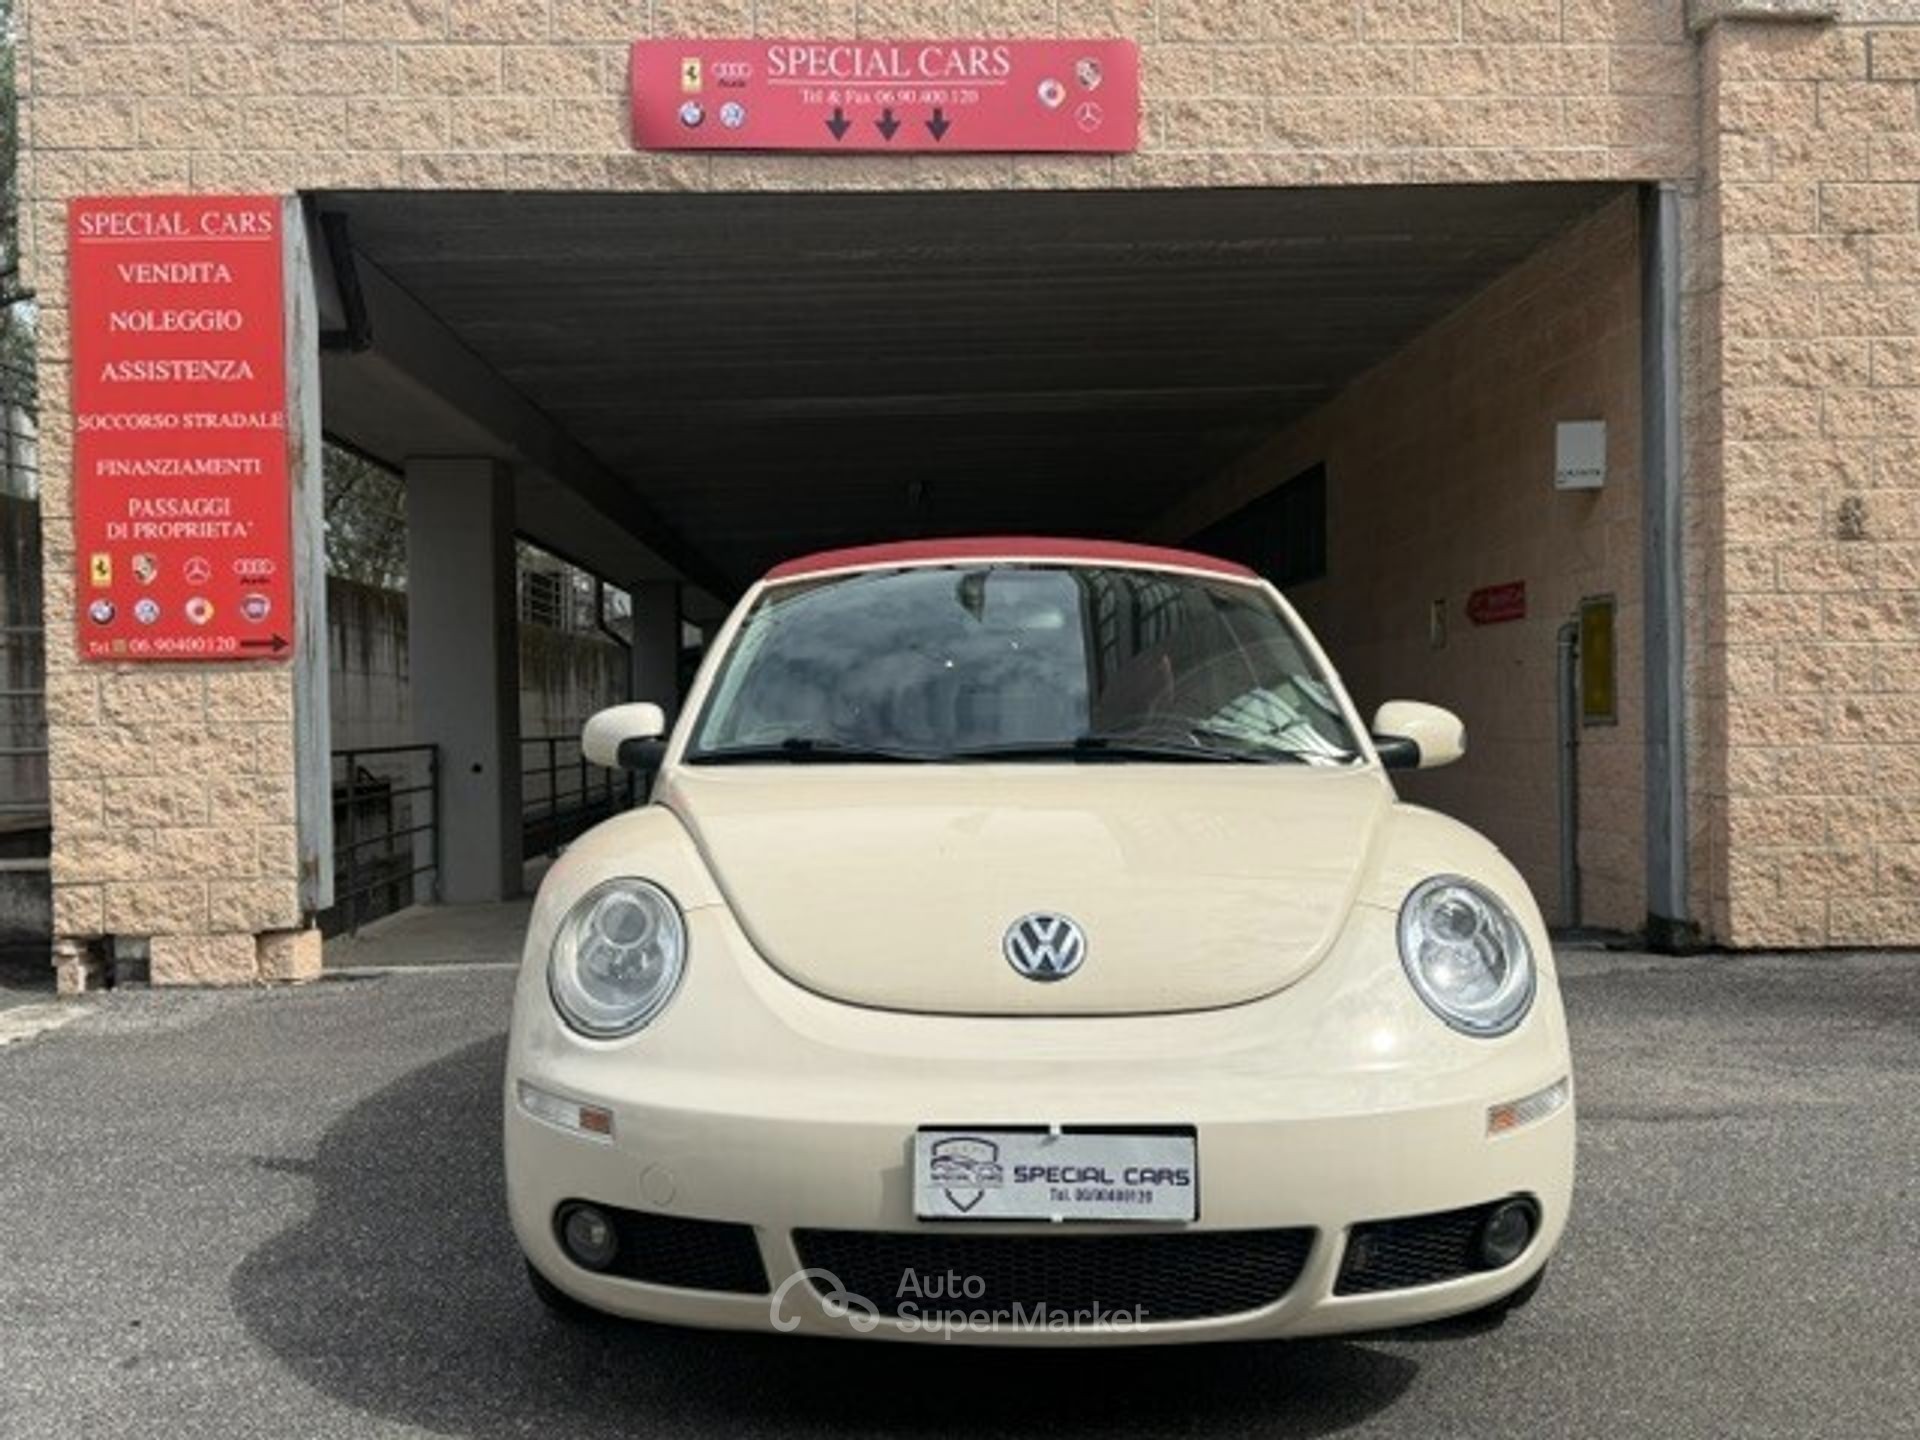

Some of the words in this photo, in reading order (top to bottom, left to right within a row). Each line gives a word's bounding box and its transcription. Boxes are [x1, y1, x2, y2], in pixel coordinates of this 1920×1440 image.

[767, 46, 912, 77] SPECIAL
[918, 45, 1011, 76] CARS
[79, 212, 190, 235] SPECIAL
[201, 211, 272, 233] CARS
[117, 263, 232, 283] VENDITA
[109, 309, 242, 331] NOLEGGIO
[101, 360, 254, 381] ASSISTENZA
[77, 413, 178, 430] SOCCORSO
[183, 412, 284, 429] STRADALE
[96, 459, 262, 476] FINANZIAMENTI
[128, 498, 231, 517] PASSAGGI
[107, 522, 128, 538] DI
[1014, 1166, 1115, 1184] SPECIAL
[1123, 1167, 1191, 1186] CARS
